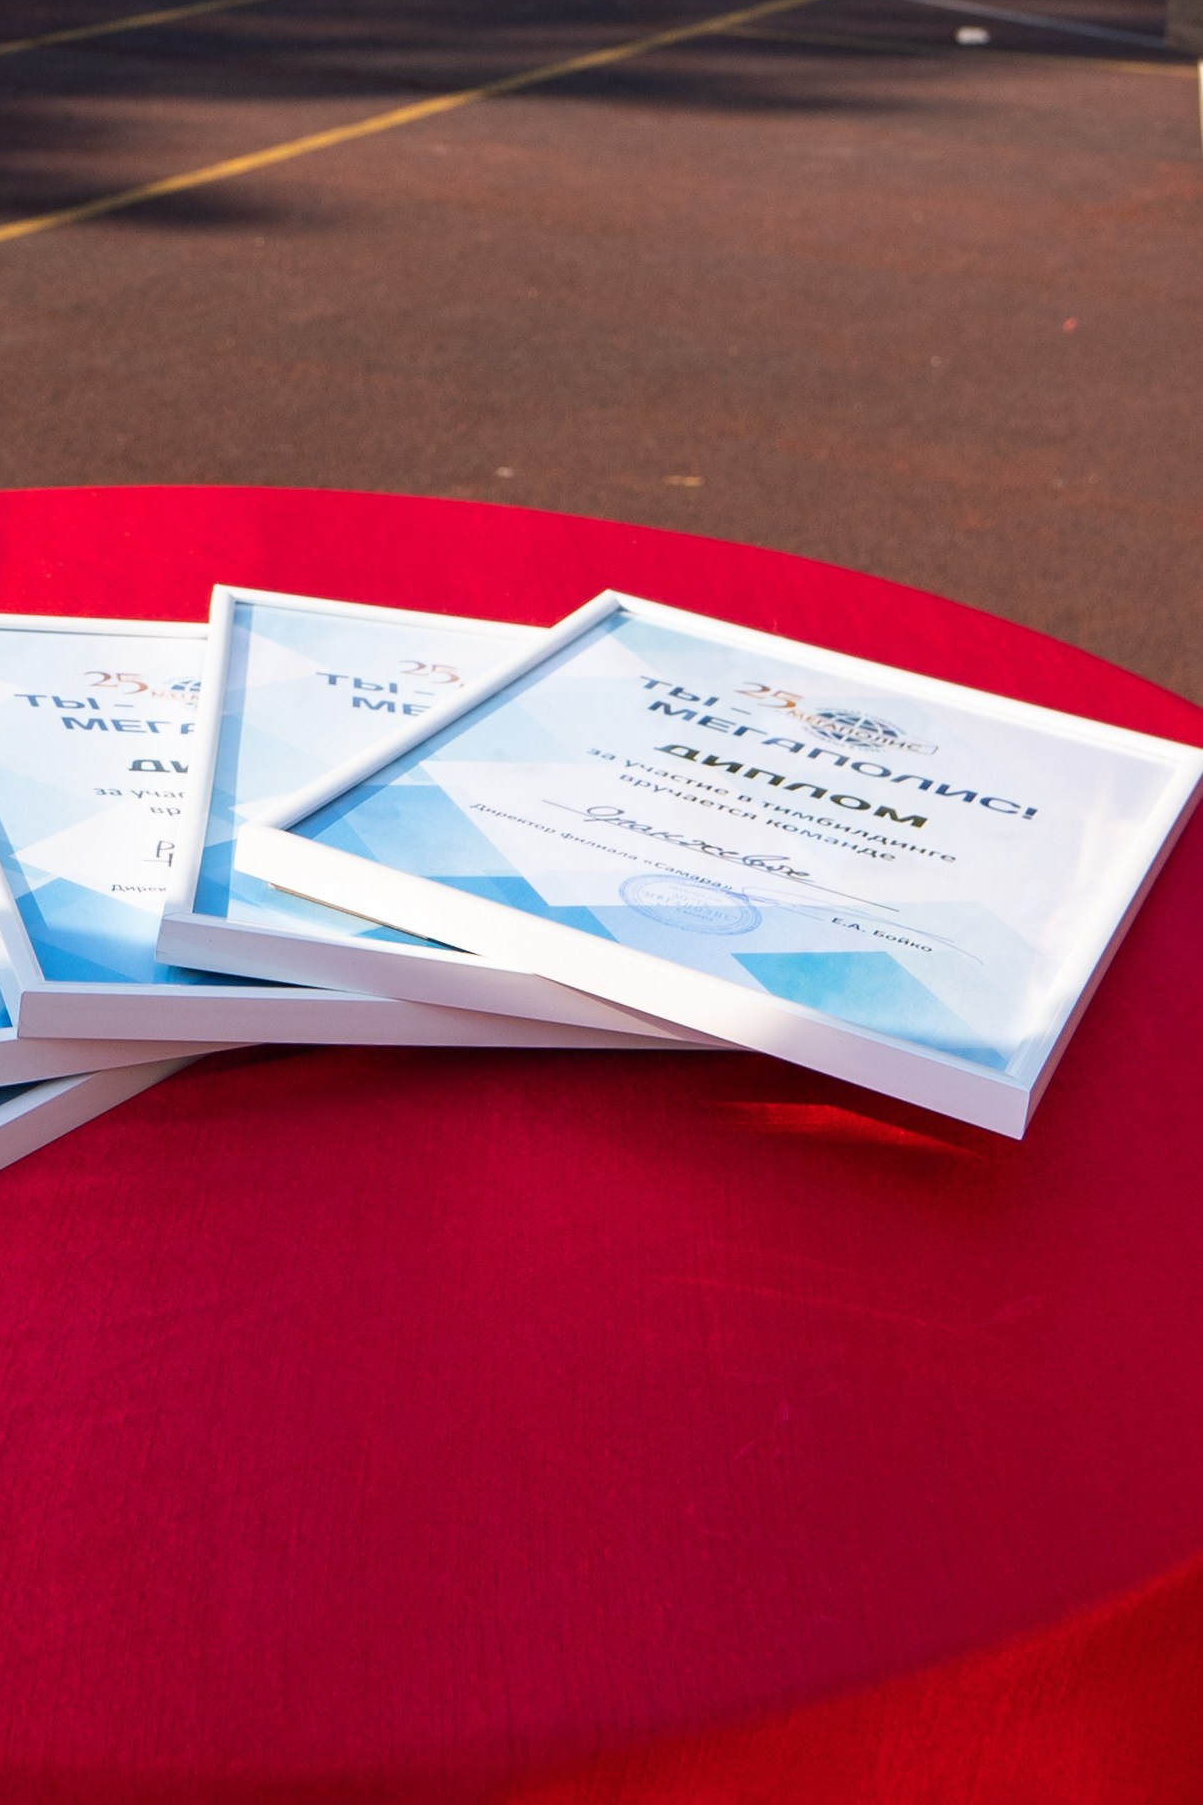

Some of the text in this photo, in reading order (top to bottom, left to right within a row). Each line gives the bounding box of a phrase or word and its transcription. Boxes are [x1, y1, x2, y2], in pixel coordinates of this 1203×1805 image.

[84, 671, 149, 695] 25
[315, 672, 399, 694] ТЫ
[398, 660, 461, 684] 25
[14, 694, 100, 710] ТЫ
[640, 675, 721, 707] ТЫ
[733, 681, 803, 710] 25
[647, 700, 1038, 821] МЕГАПОЛИС!
[653, 743, 929, 828] ДИПЛОМ
[586, 748, 957, 863] за участие в тимбилдинге
[619, 773, 897, 862] вручается команде
[470, 803, 557, 834] Директор
[560, 831, 638, 861] филиала
[873, 929, 933, 953] Бойко
